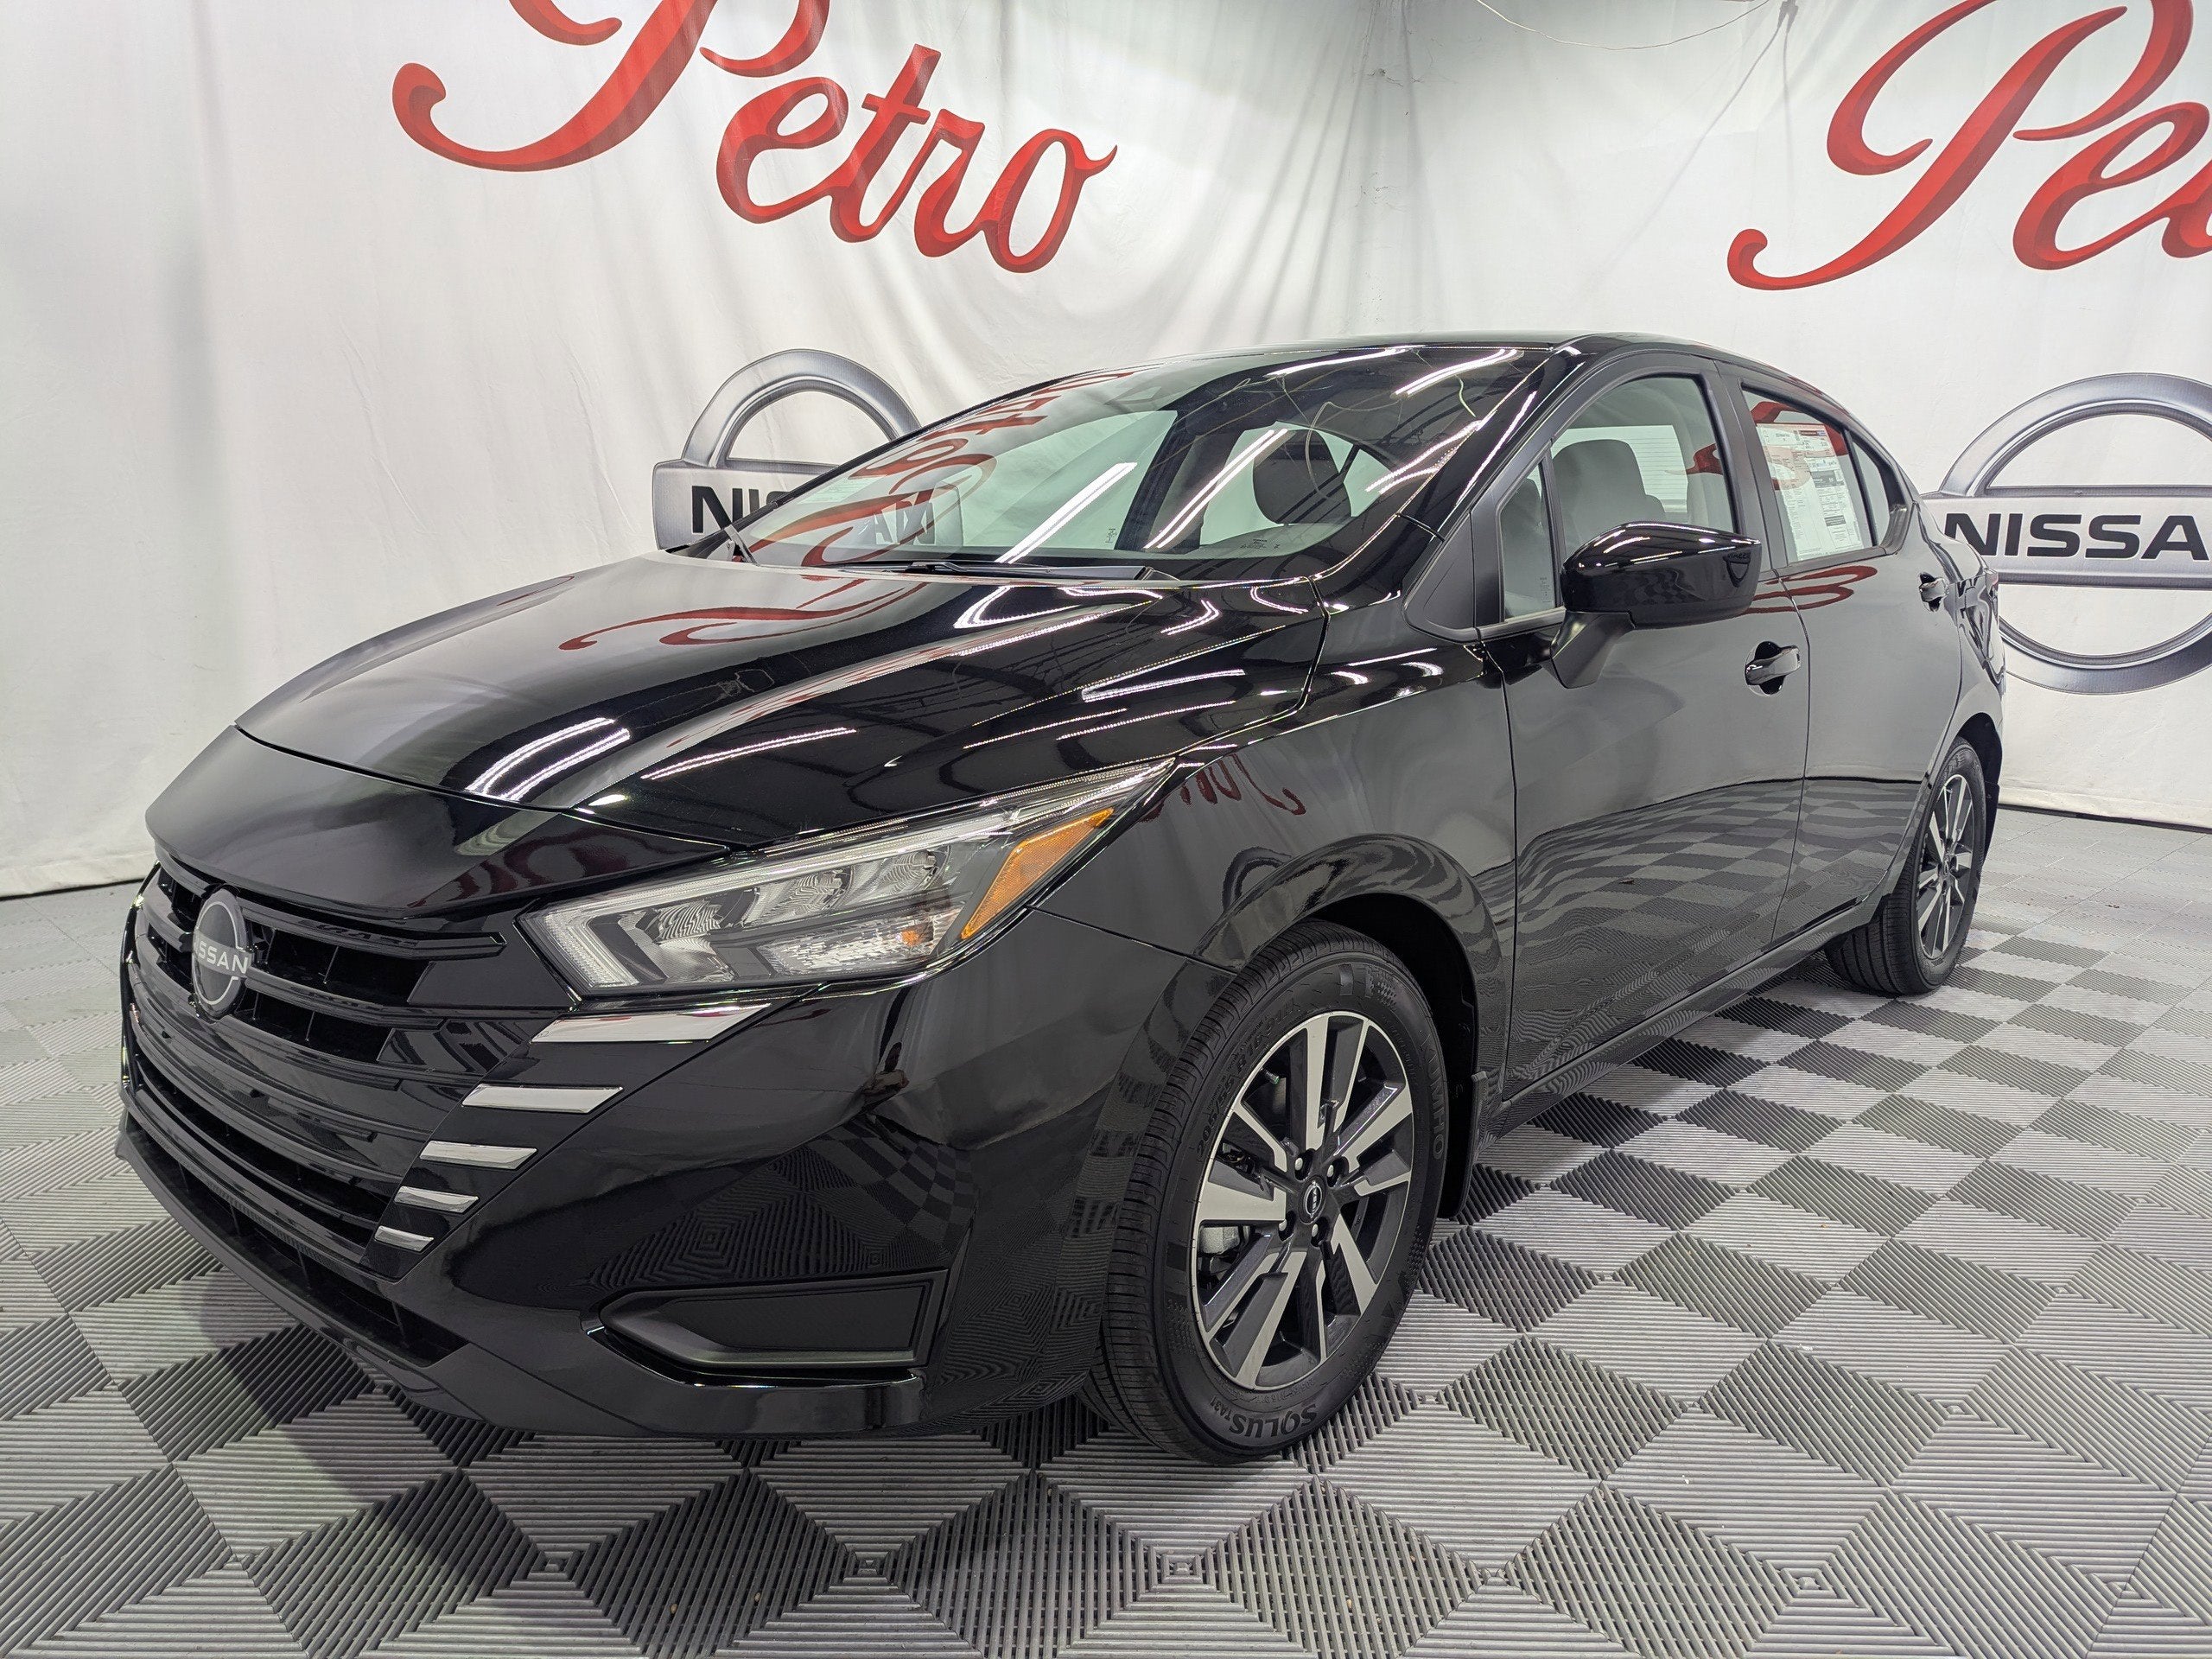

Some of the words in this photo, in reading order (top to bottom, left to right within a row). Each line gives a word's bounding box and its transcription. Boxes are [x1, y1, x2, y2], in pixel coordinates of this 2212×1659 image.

[392, 0, 1117, 273] Petro
[194, 937, 249, 974] SSAN
[1420, 1031, 1444, 1160] KUMHO
[1208, 1395, 1233, 1422] TA31
[1229, 1403, 1318, 1438] SOLUS
